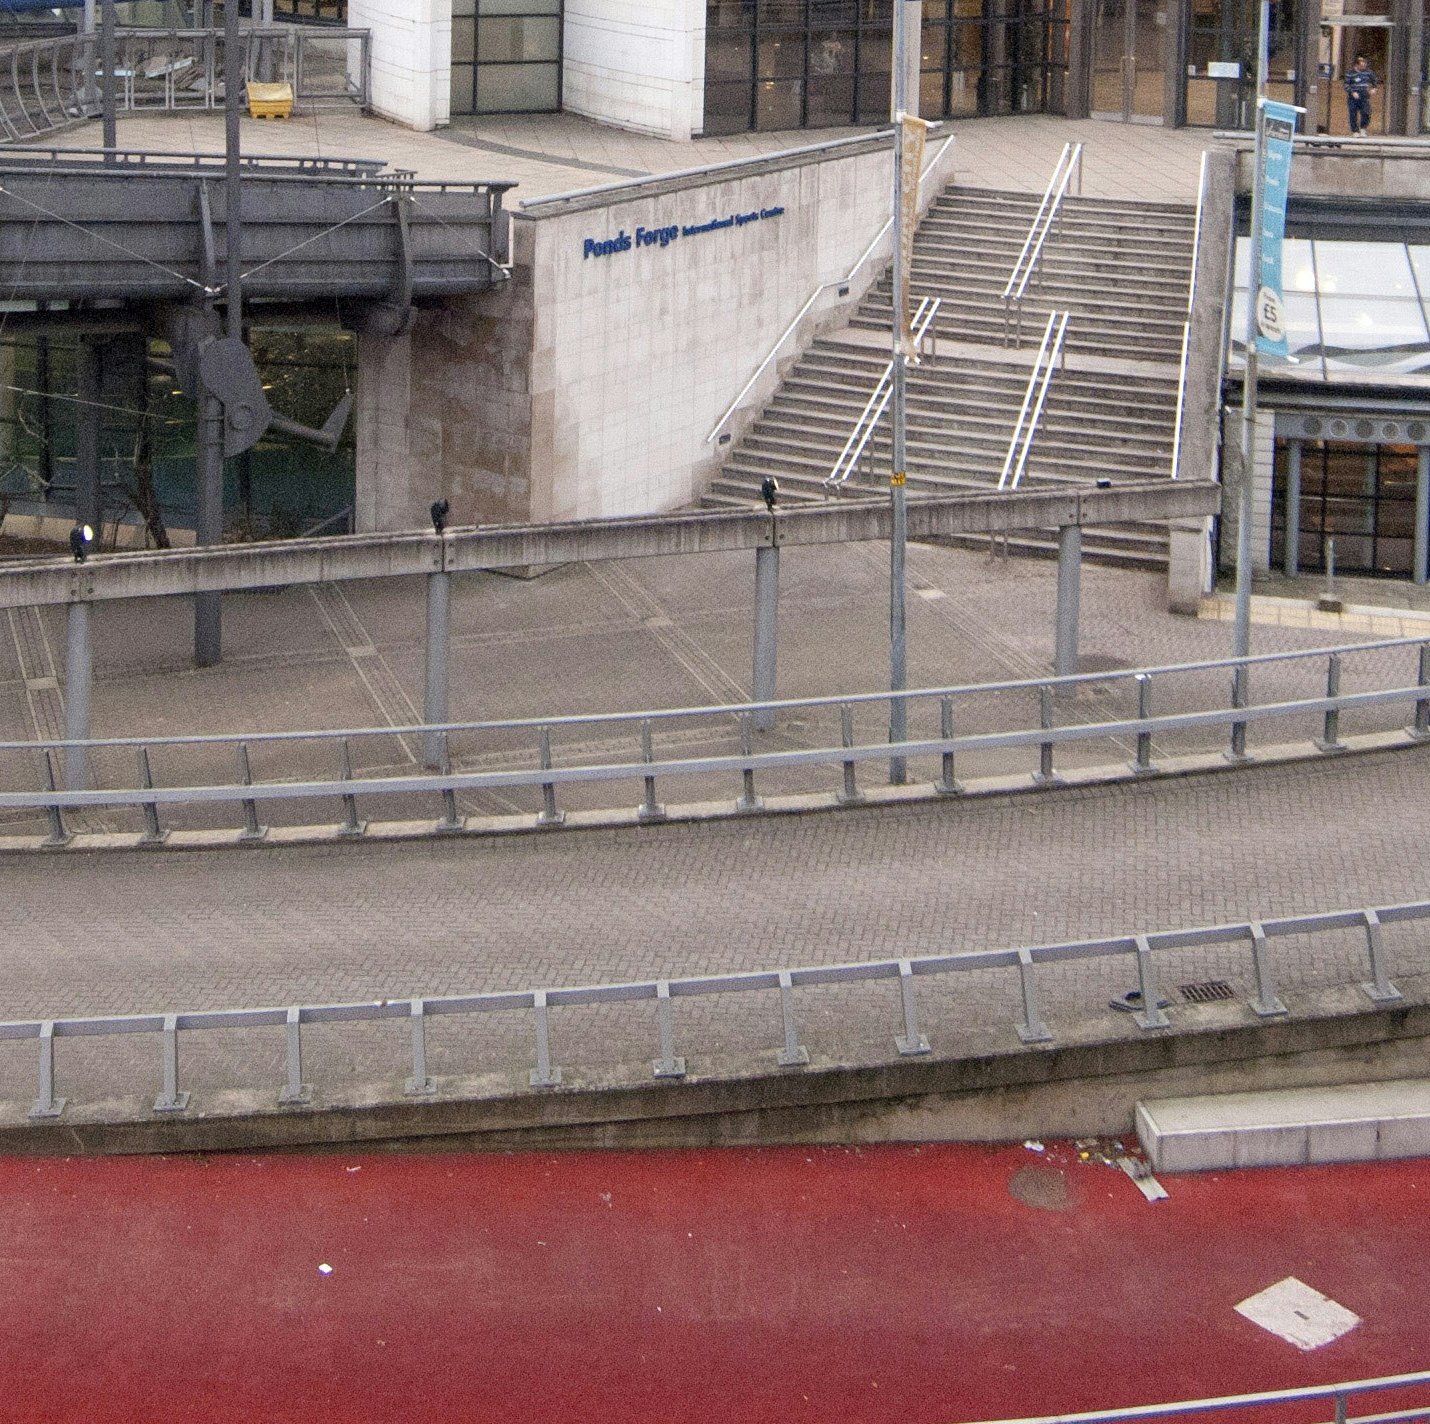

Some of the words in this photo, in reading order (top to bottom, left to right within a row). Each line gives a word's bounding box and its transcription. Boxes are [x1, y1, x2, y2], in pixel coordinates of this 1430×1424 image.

[583, 230, 632, 261] Ponds
[635, 225, 679, 247] Forge
[682, 215, 734, 237] International
[735, 211, 759, 226] Sports
